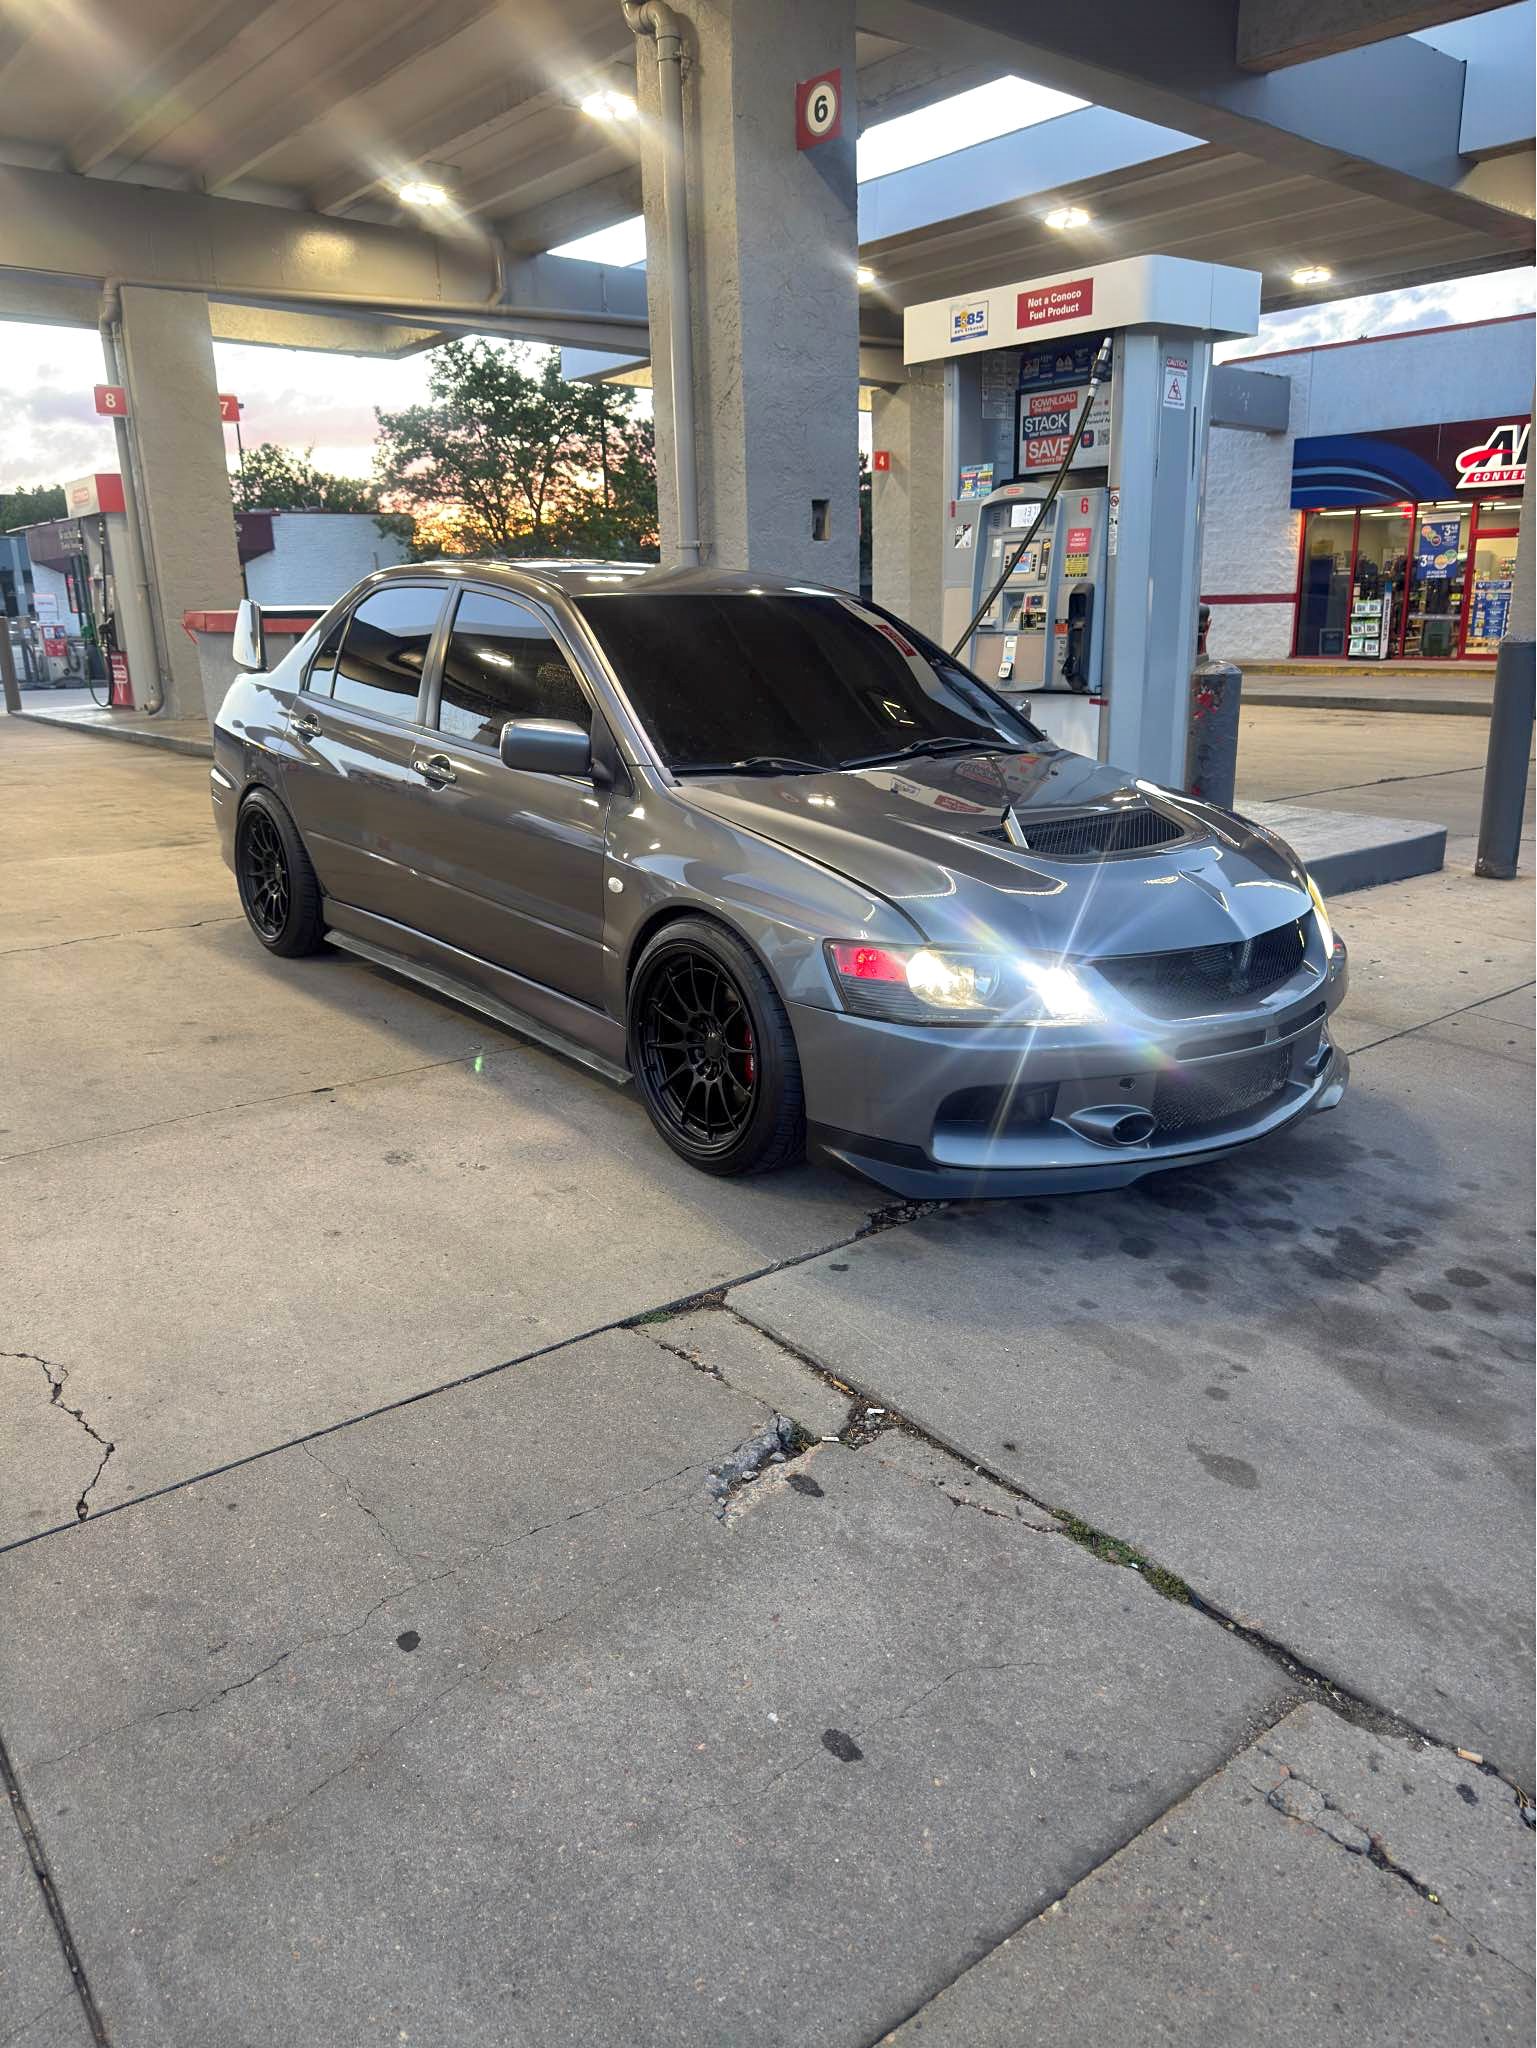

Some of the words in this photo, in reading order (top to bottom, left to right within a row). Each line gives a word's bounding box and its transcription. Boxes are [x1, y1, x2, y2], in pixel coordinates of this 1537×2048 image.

[814, 95, 828, 123] 6
[1027, 297, 1042, 309] Not
[1044, 296, 1049, 305] a
[1050, 290, 1082, 304] Conoco
[1029, 308, 1046, 320] Fuel
[1047, 302, 1079, 317] Product
[105, 393, 116, 408] 8
[220, 401, 229, 415] 7
[1031, 392, 1077, 409] DOWNLOAD
[1024, 413, 1068, 433] STACK
[1028, 436, 1072, 459] SAVE
[1081, 497, 1089, 514] 6
